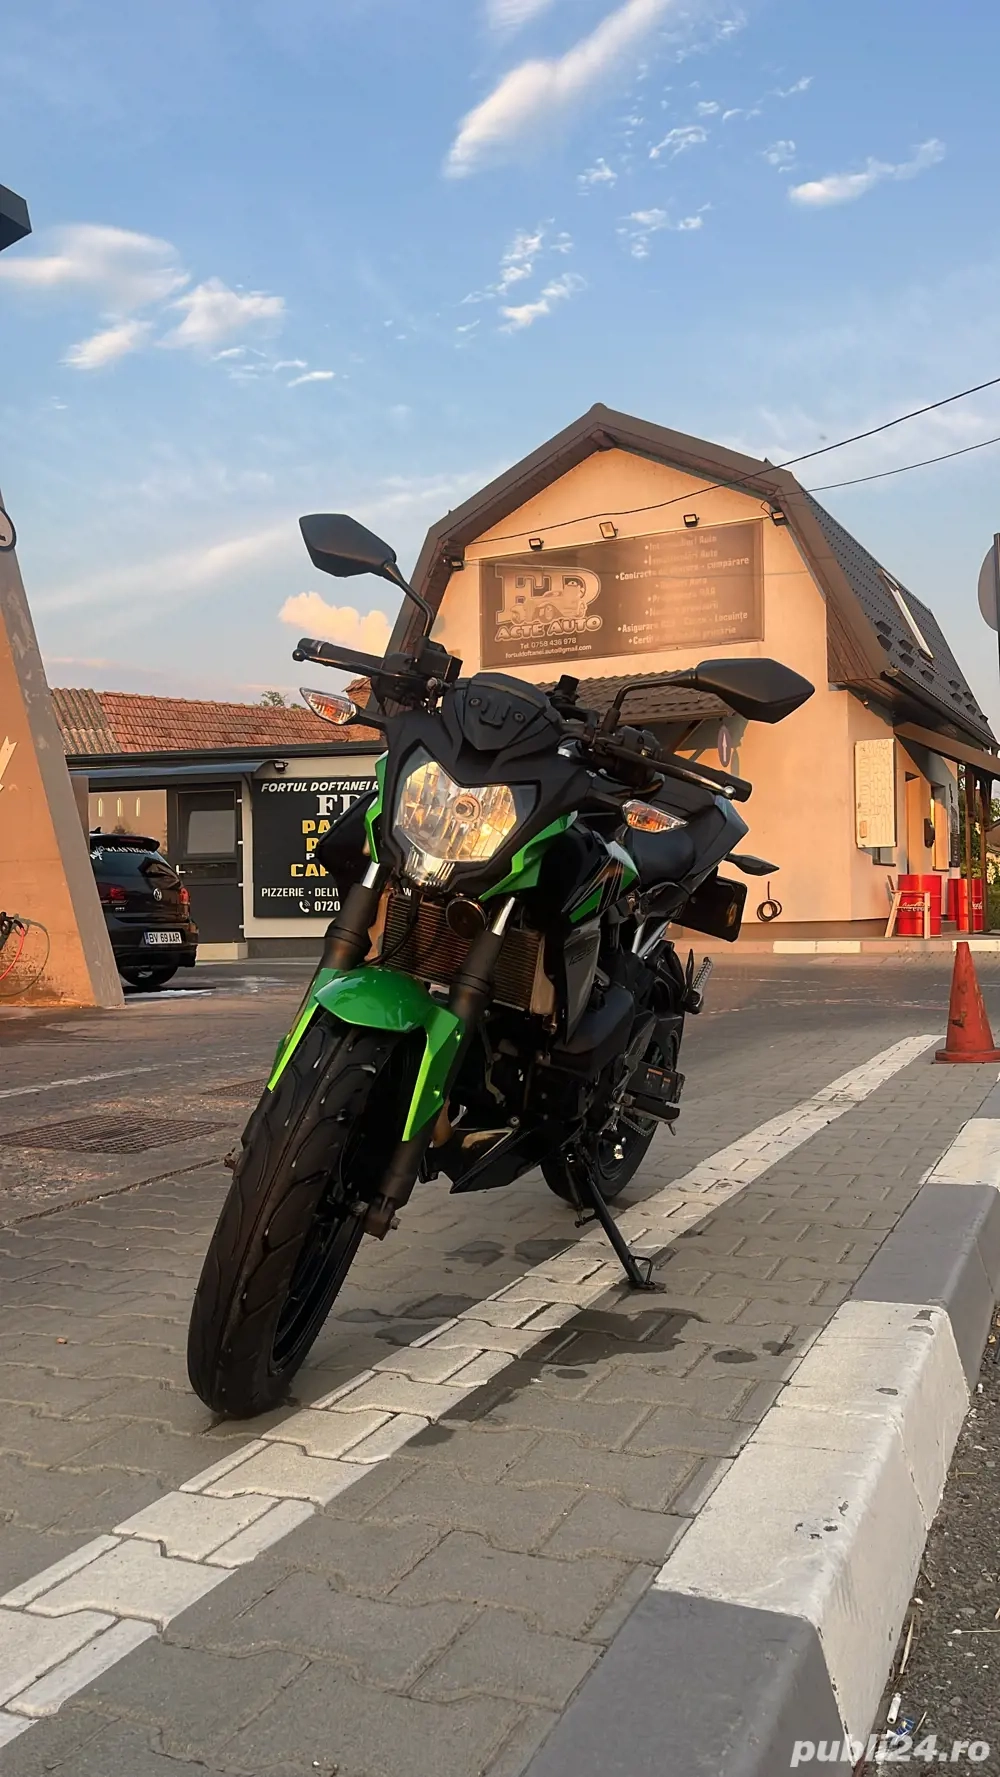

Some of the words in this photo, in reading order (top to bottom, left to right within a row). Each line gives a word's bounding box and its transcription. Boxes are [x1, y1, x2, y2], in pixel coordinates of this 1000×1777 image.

[495, 623, 546, 642] ACTE
[547, 615, 603, 636] AUTO
[531, 640, 548, 648] 0758
[563, 637, 577, 645] 978
[261, 782, 308, 793] FORTUL
[310, 781, 371, 792] DOFTANEI
[261, 887, 305, 897] PIZZERIE
[314, 900, 341, 912] 0720
[148, 933, 158, 943] BV
[160, 933, 168, 942] 69
